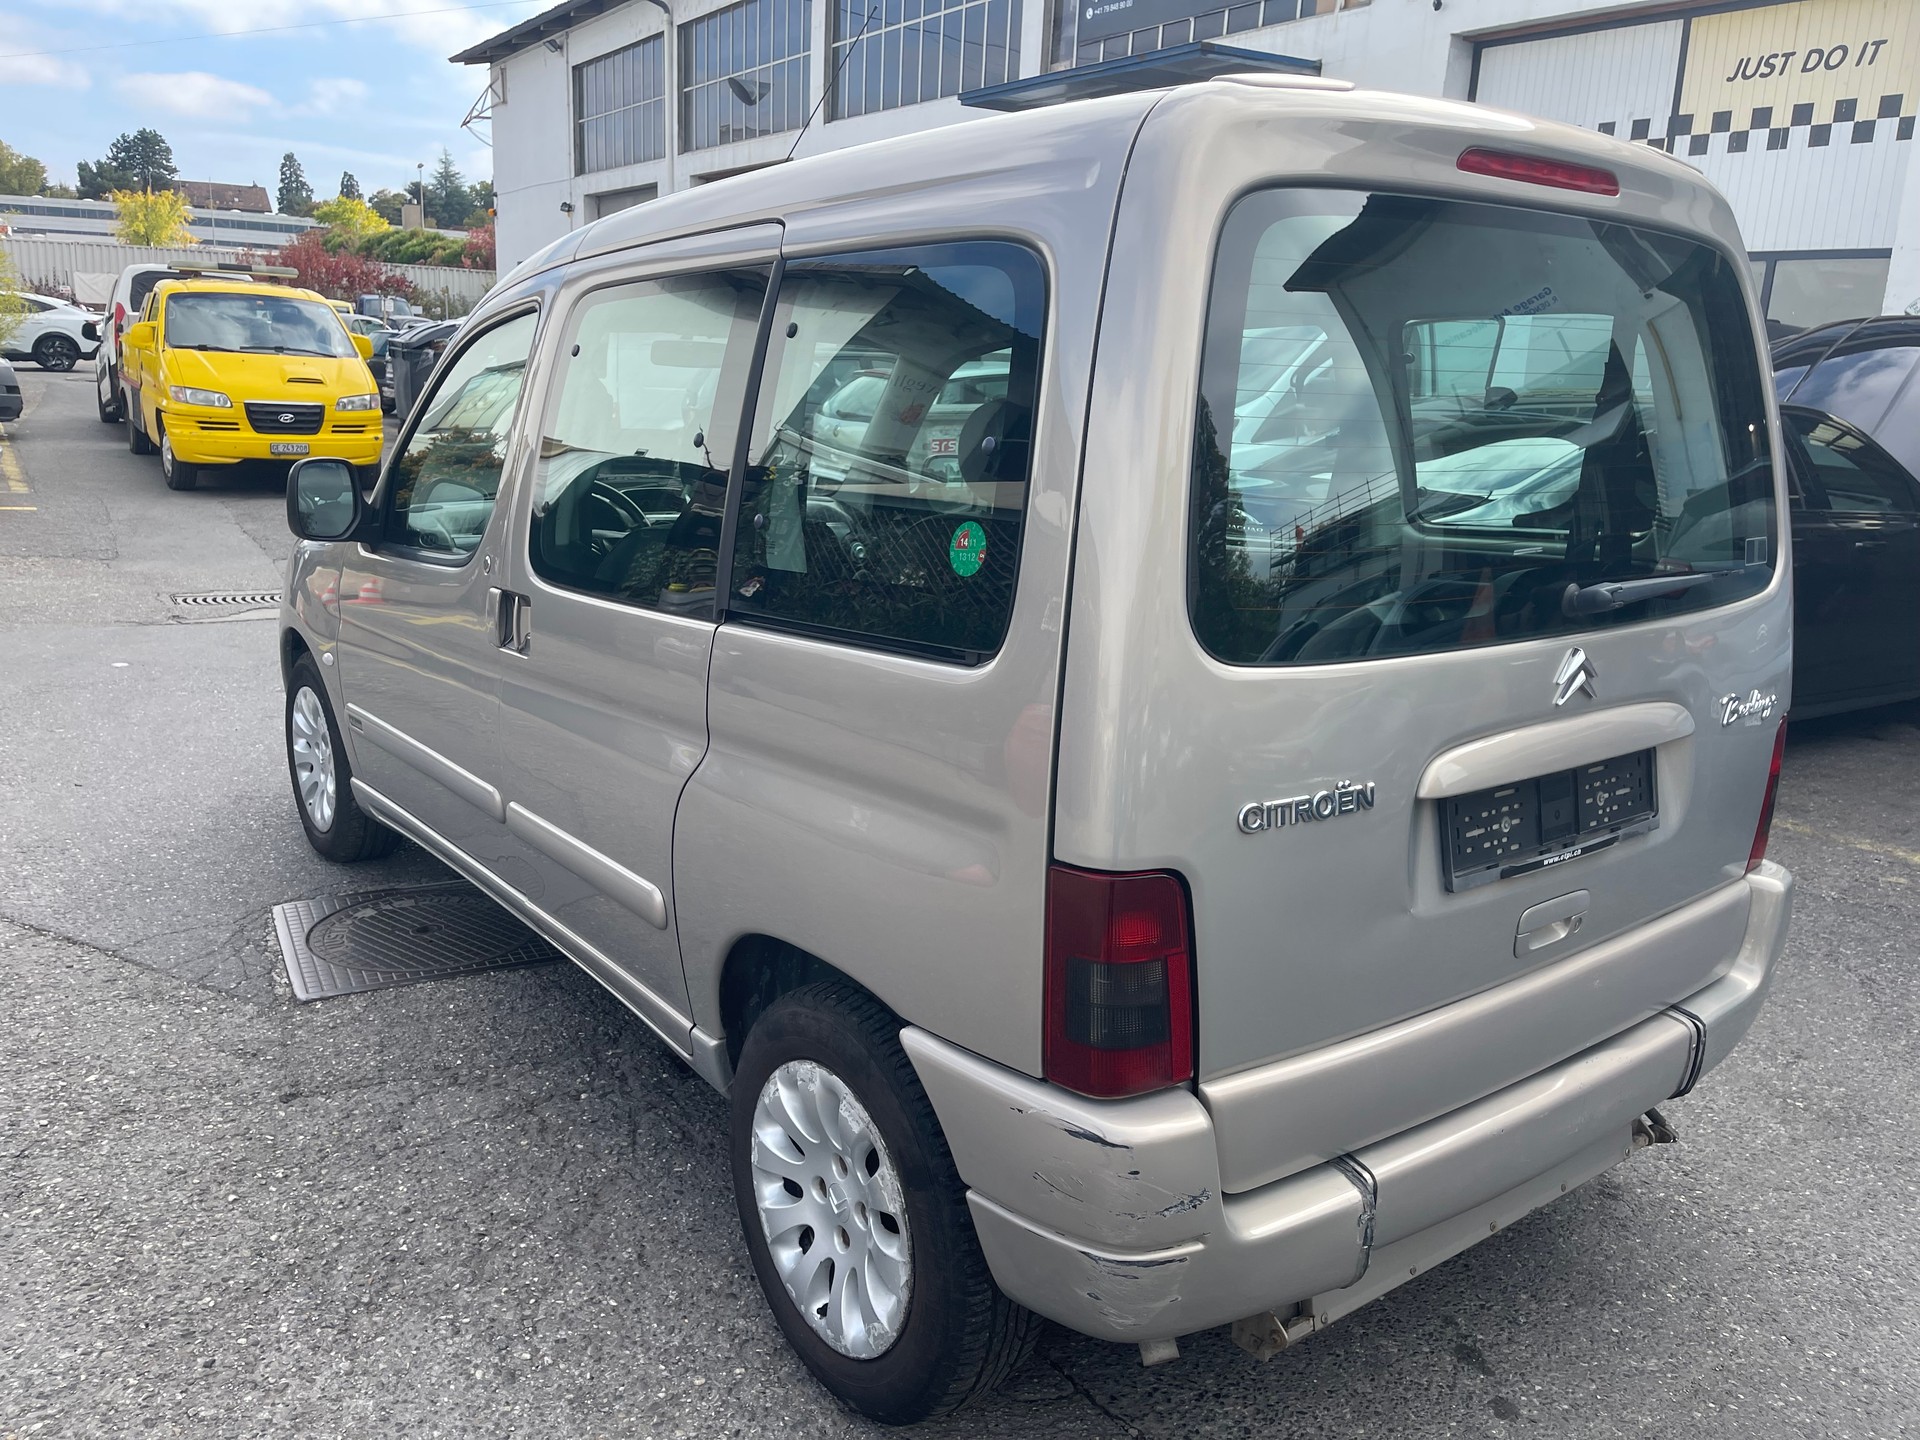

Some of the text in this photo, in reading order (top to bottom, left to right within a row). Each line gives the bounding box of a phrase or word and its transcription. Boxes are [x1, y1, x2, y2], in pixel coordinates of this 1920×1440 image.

[1726, 39, 1889, 82] JUST DO IT
[960, 537, 968, 547] 14
[1237, 779, 1376, 834] CITROËN
